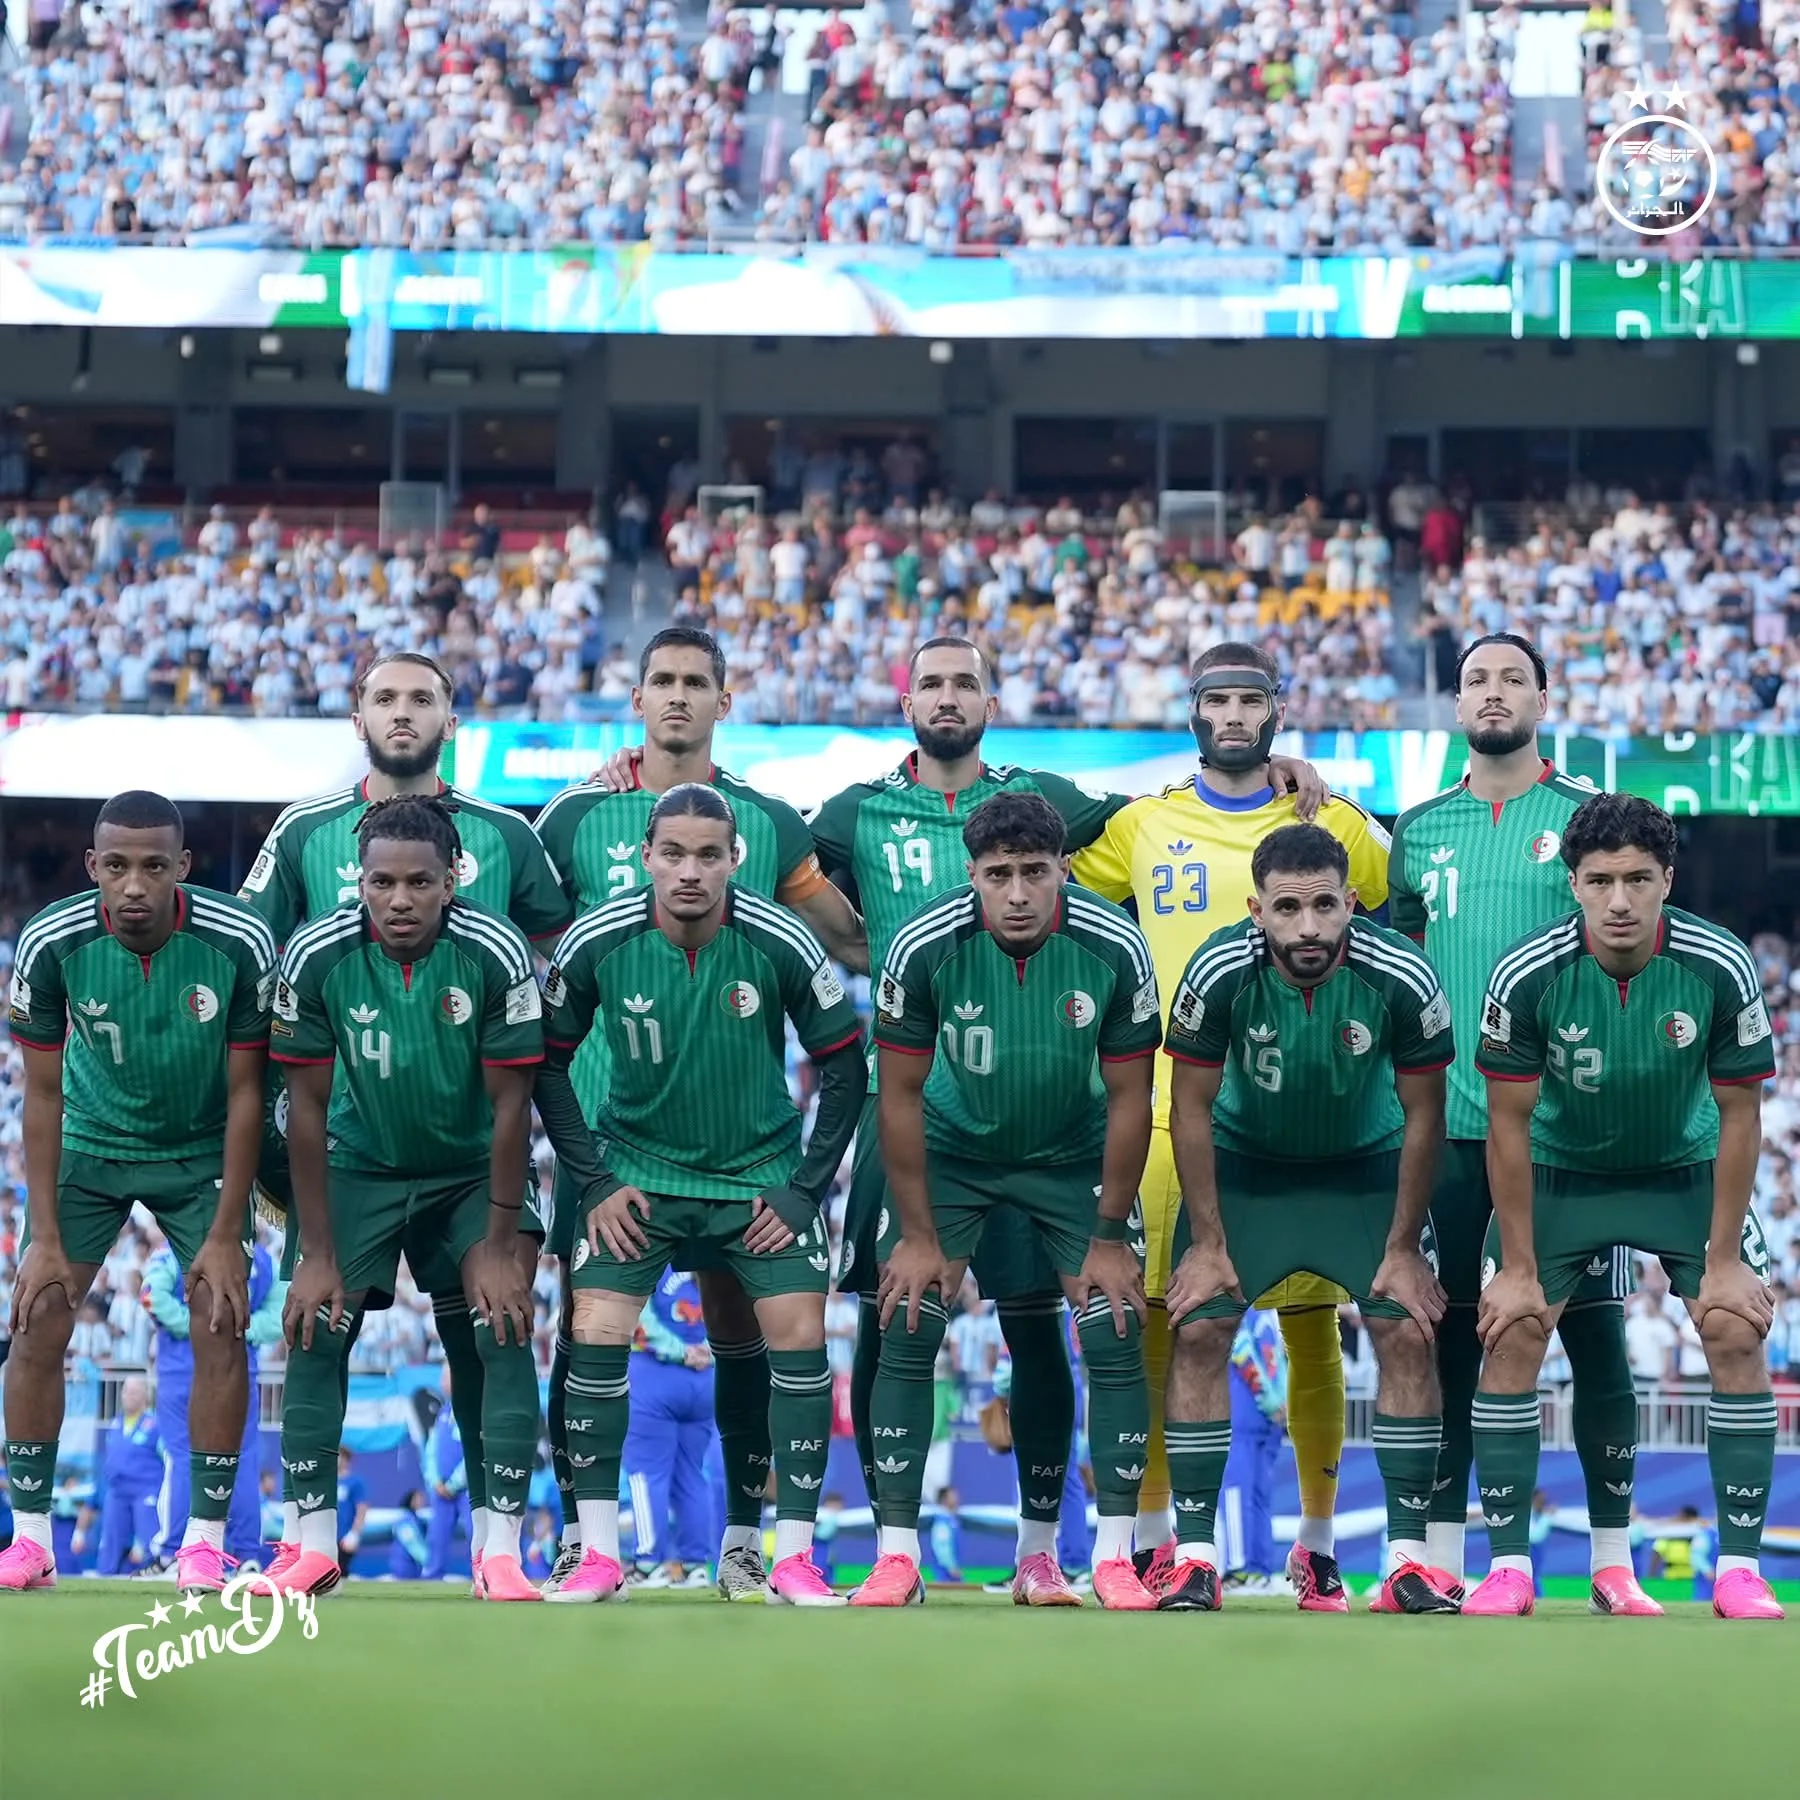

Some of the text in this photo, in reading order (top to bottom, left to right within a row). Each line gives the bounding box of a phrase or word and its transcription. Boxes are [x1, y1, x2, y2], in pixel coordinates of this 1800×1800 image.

[882, 838, 933, 893] 19
[1152, 863, 1208, 915] 23
[1420, 867, 1459, 921] 21
[73, 1012, 123, 1065] 17
[621, 1016, 664, 1064] 11
[344, 1023, 391, 1080] 14
[943, 1021, 993, 1076] 10
[1242, 1038, 1282, 1092] 15
[1546, 1040, 1602, 1092] 22
[564, 1419, 595, 1431] FAF
[873, 1427, 908, 1439] FAF
[9, 1445, 42, 1456] FAF
[790, 1439, 824, 1451] FAF
[1606, 1444, 1638, 1459] FAF
[206, 1455, 238, 1466] FAF
[289, 1459, 319, 1474] FAF
[748, 1453, 771, 1466] FA
[494, 1463, 527, 1479] FAF
[1031, 1464, 1065, 1477] FAF
[1480, 1485, 1514, 1498] FAF
[1725, 1484, 1764, 1498] FAF
